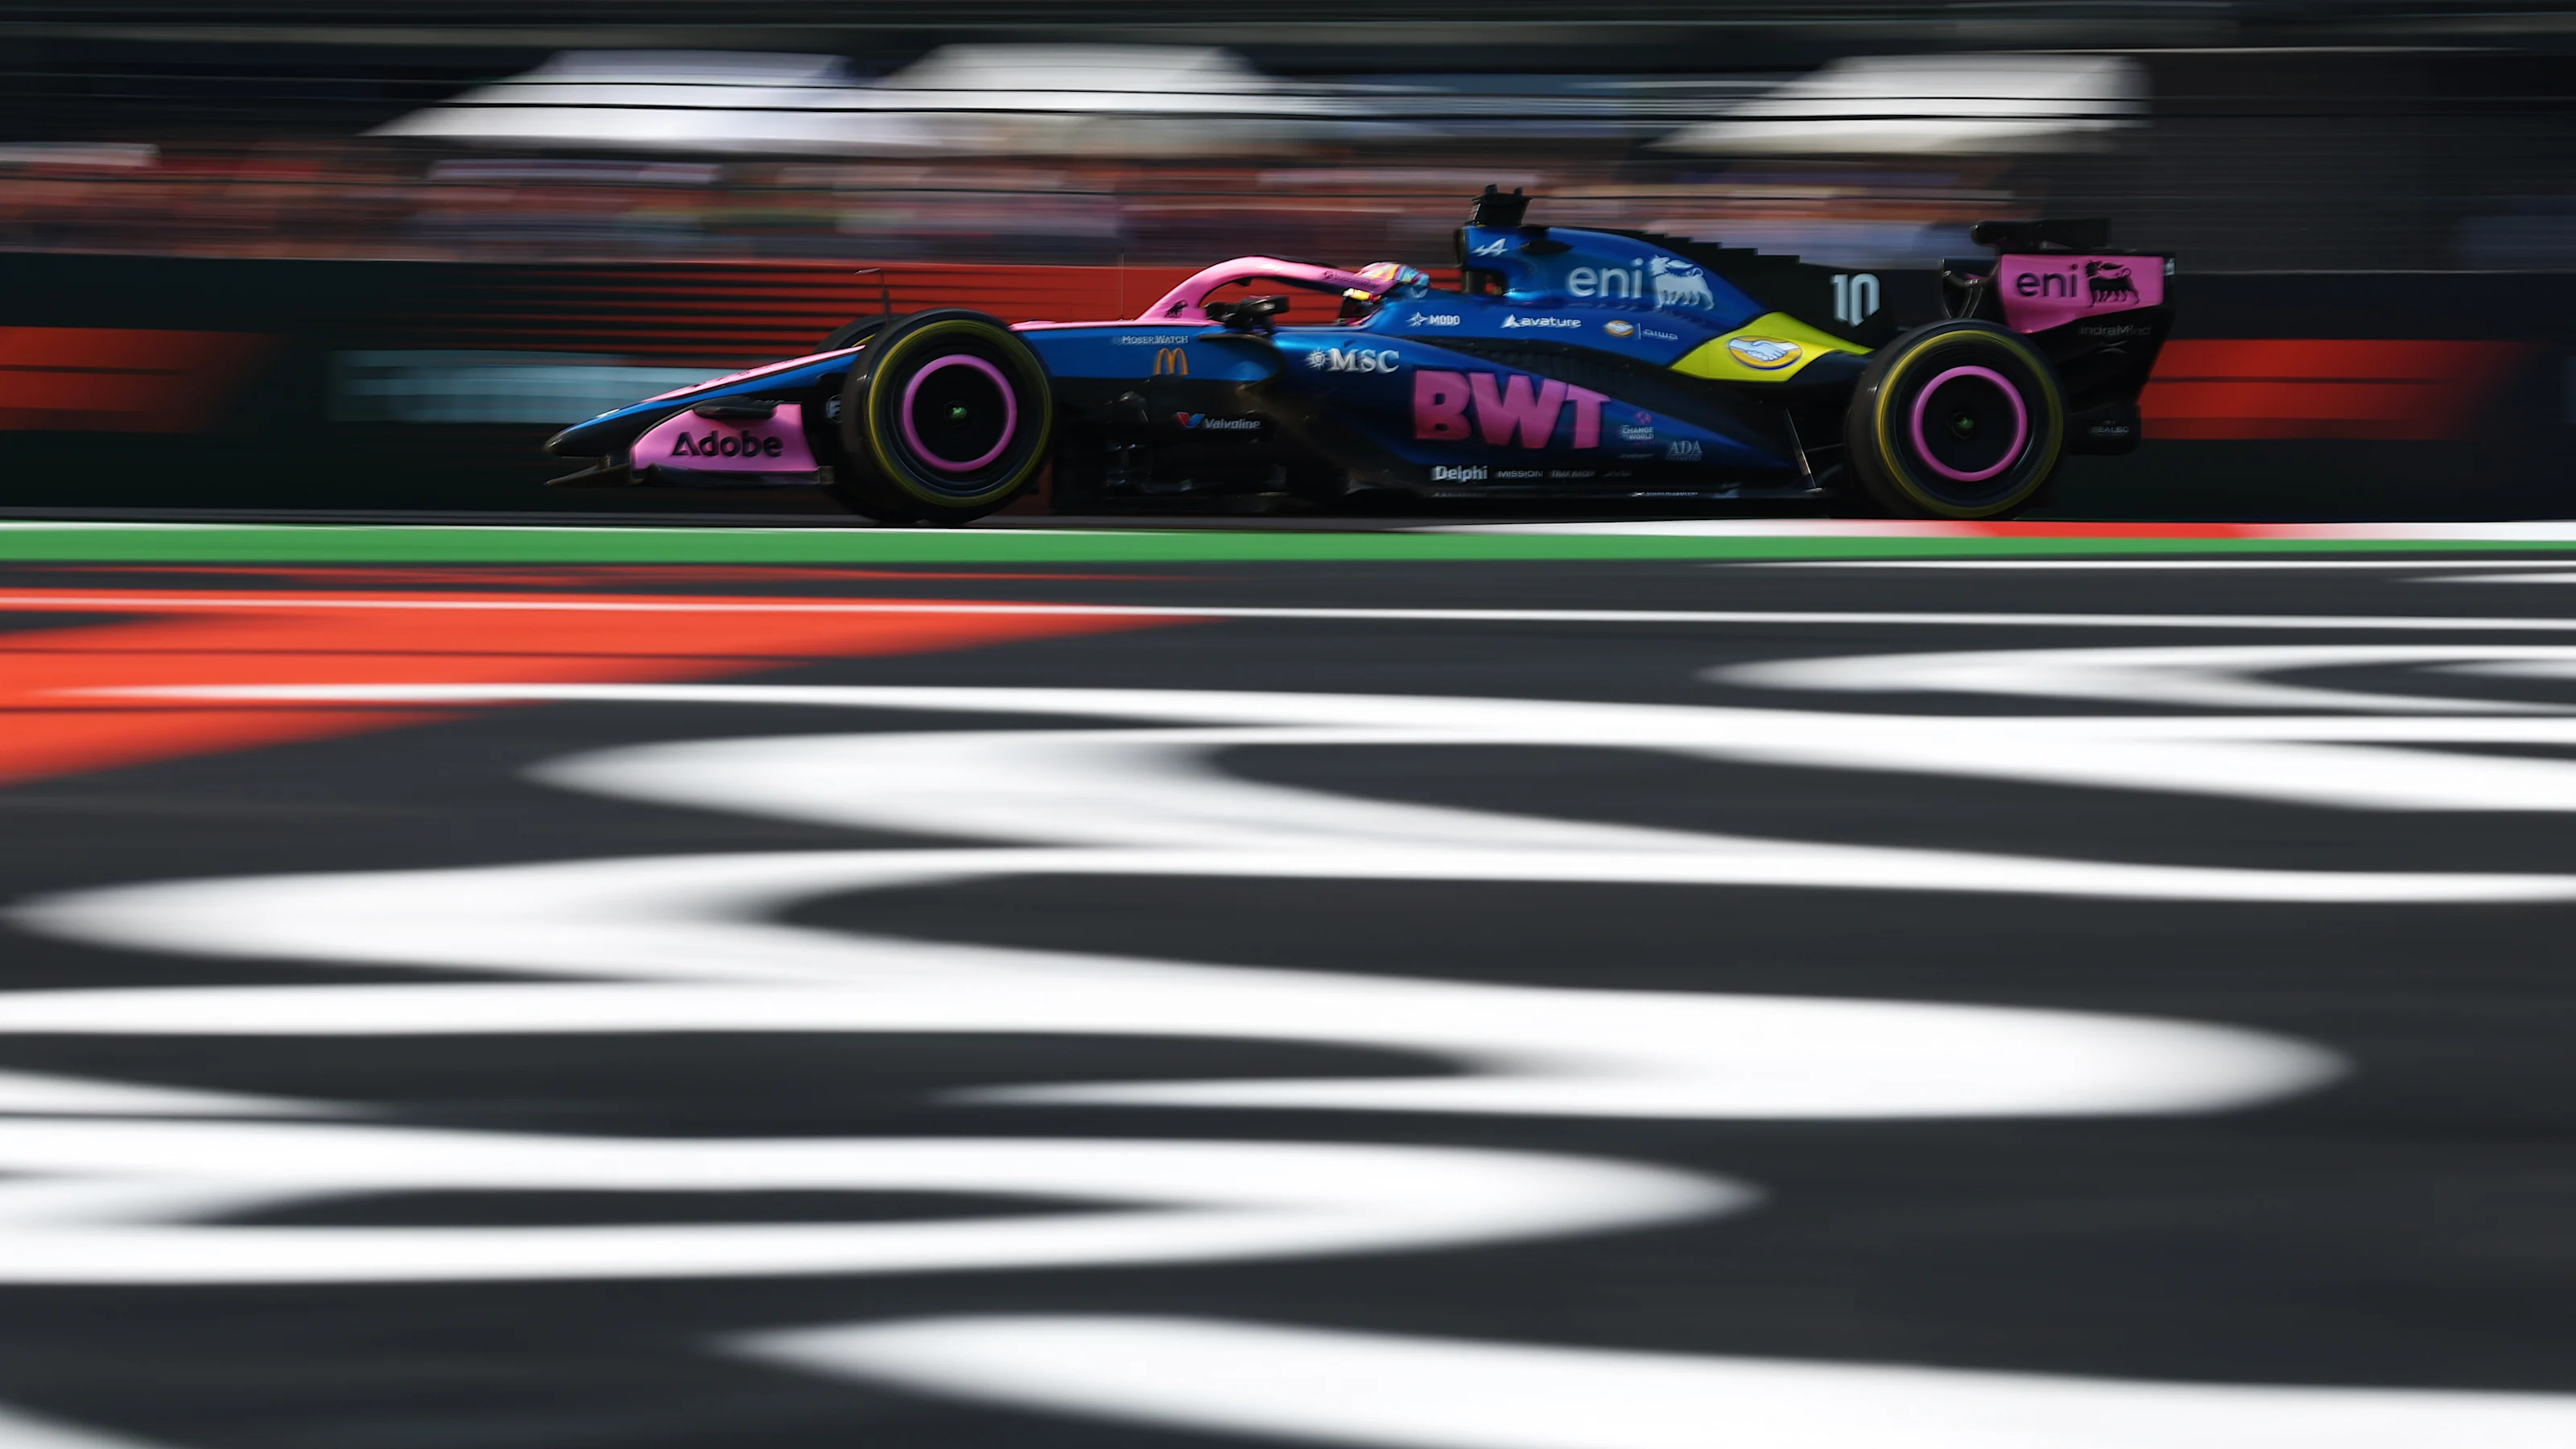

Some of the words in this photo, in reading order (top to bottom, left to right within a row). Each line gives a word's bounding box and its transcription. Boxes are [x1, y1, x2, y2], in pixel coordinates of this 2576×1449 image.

[1568, 258, 1644, 299] eni
[2017, 264, 2079, 297] eni
[1831, 273, 1880, 327] 10
[1427, 315, 1461, 326] MODO
[1520, 316, 1582, 329] avature
[1644, 328, 1679, 341] aiwa
[1327, 348, 1400, 374] MSC
[1414, 369, 1612, 449] BWT
[1203, 419, 1261, 428] Valvoline
[671, 430, 785, 457] Adobe
[1668, 440, 1703, 455] ADA
[1432, 465, 1488, 482] Delphi
